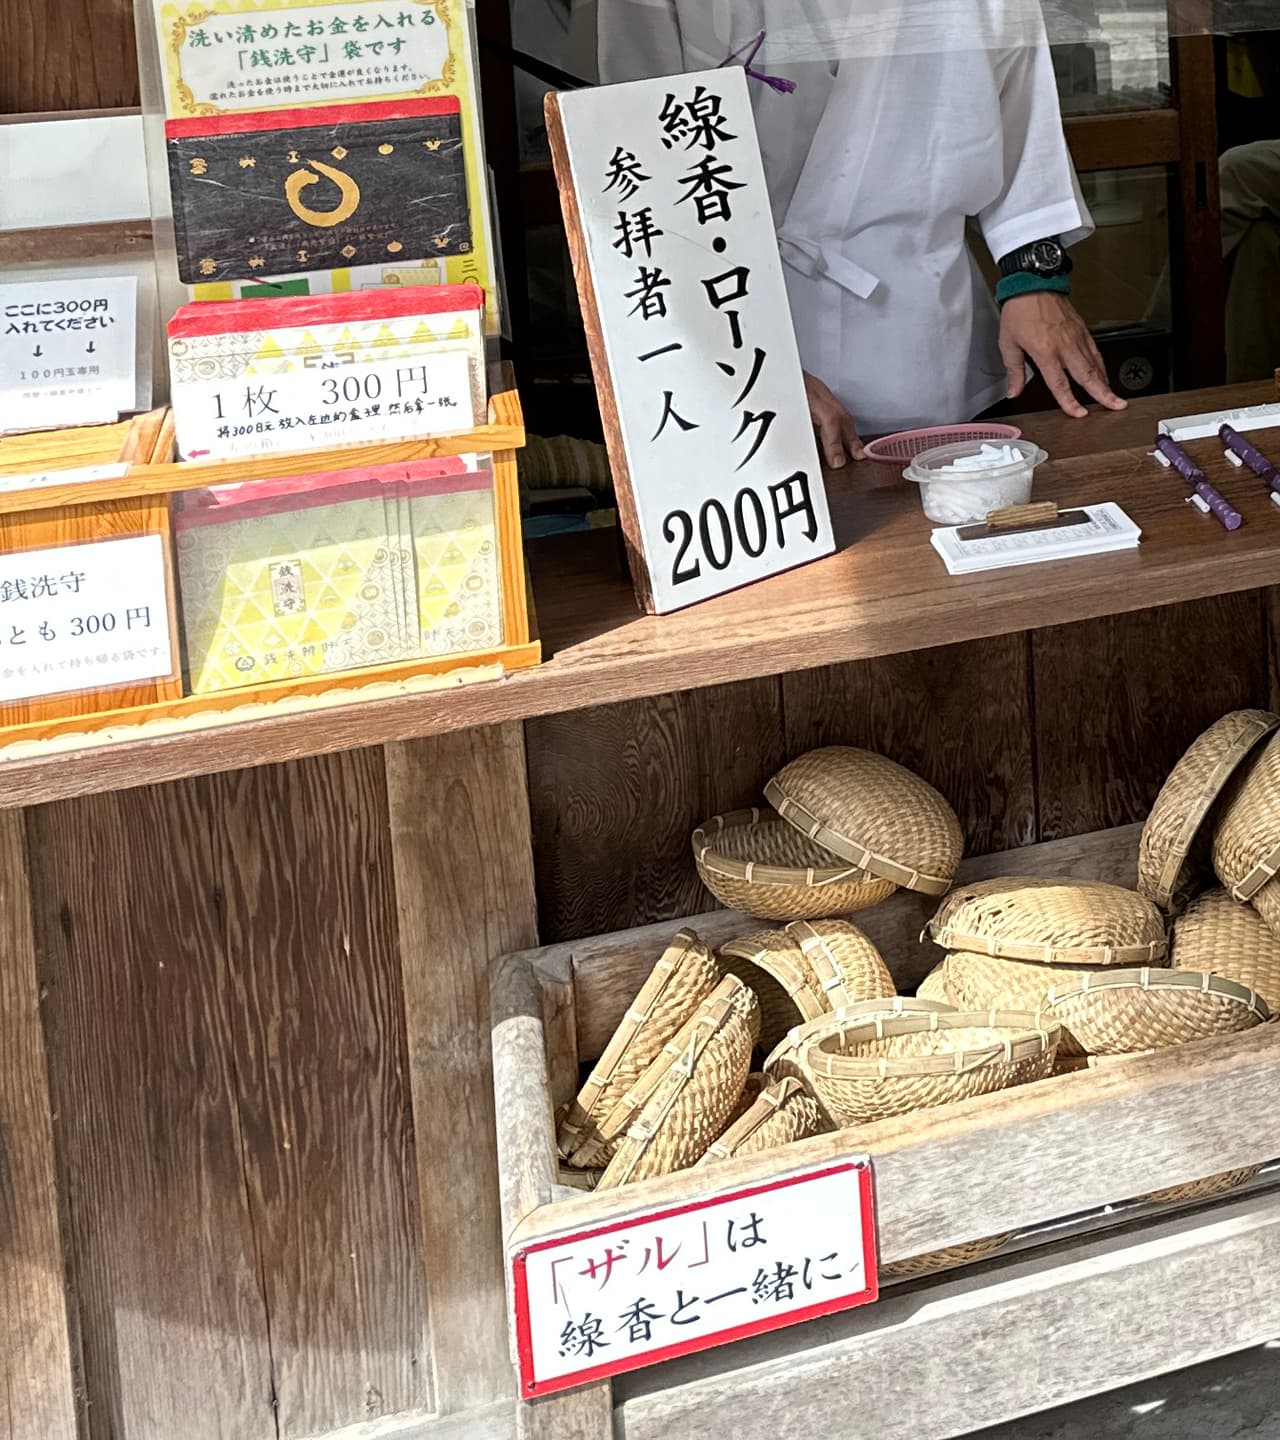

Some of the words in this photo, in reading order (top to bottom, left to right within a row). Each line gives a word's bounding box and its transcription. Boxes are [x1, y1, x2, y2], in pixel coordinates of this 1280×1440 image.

[189, 10, 435, 48] 洗い清めたお金を入れる
[602, 146, 701, 443] 参拝者一人
[657, 86, 777, 471] 線香・ローソク
[5, 299, 109, 317] ここに300円
[5, 316, 115, 334] 入れてください
[321, 365, 428, 405] 300円
[663, 470, 819, 586] 200円
[0, 571, 86, 602] 銭洗守
[277, 565, 297, 611] 銭洗守
[551, 1212, 767, 1304] 「ザル」は
[558, 1252, 843, 1358] 線香と一緒に
